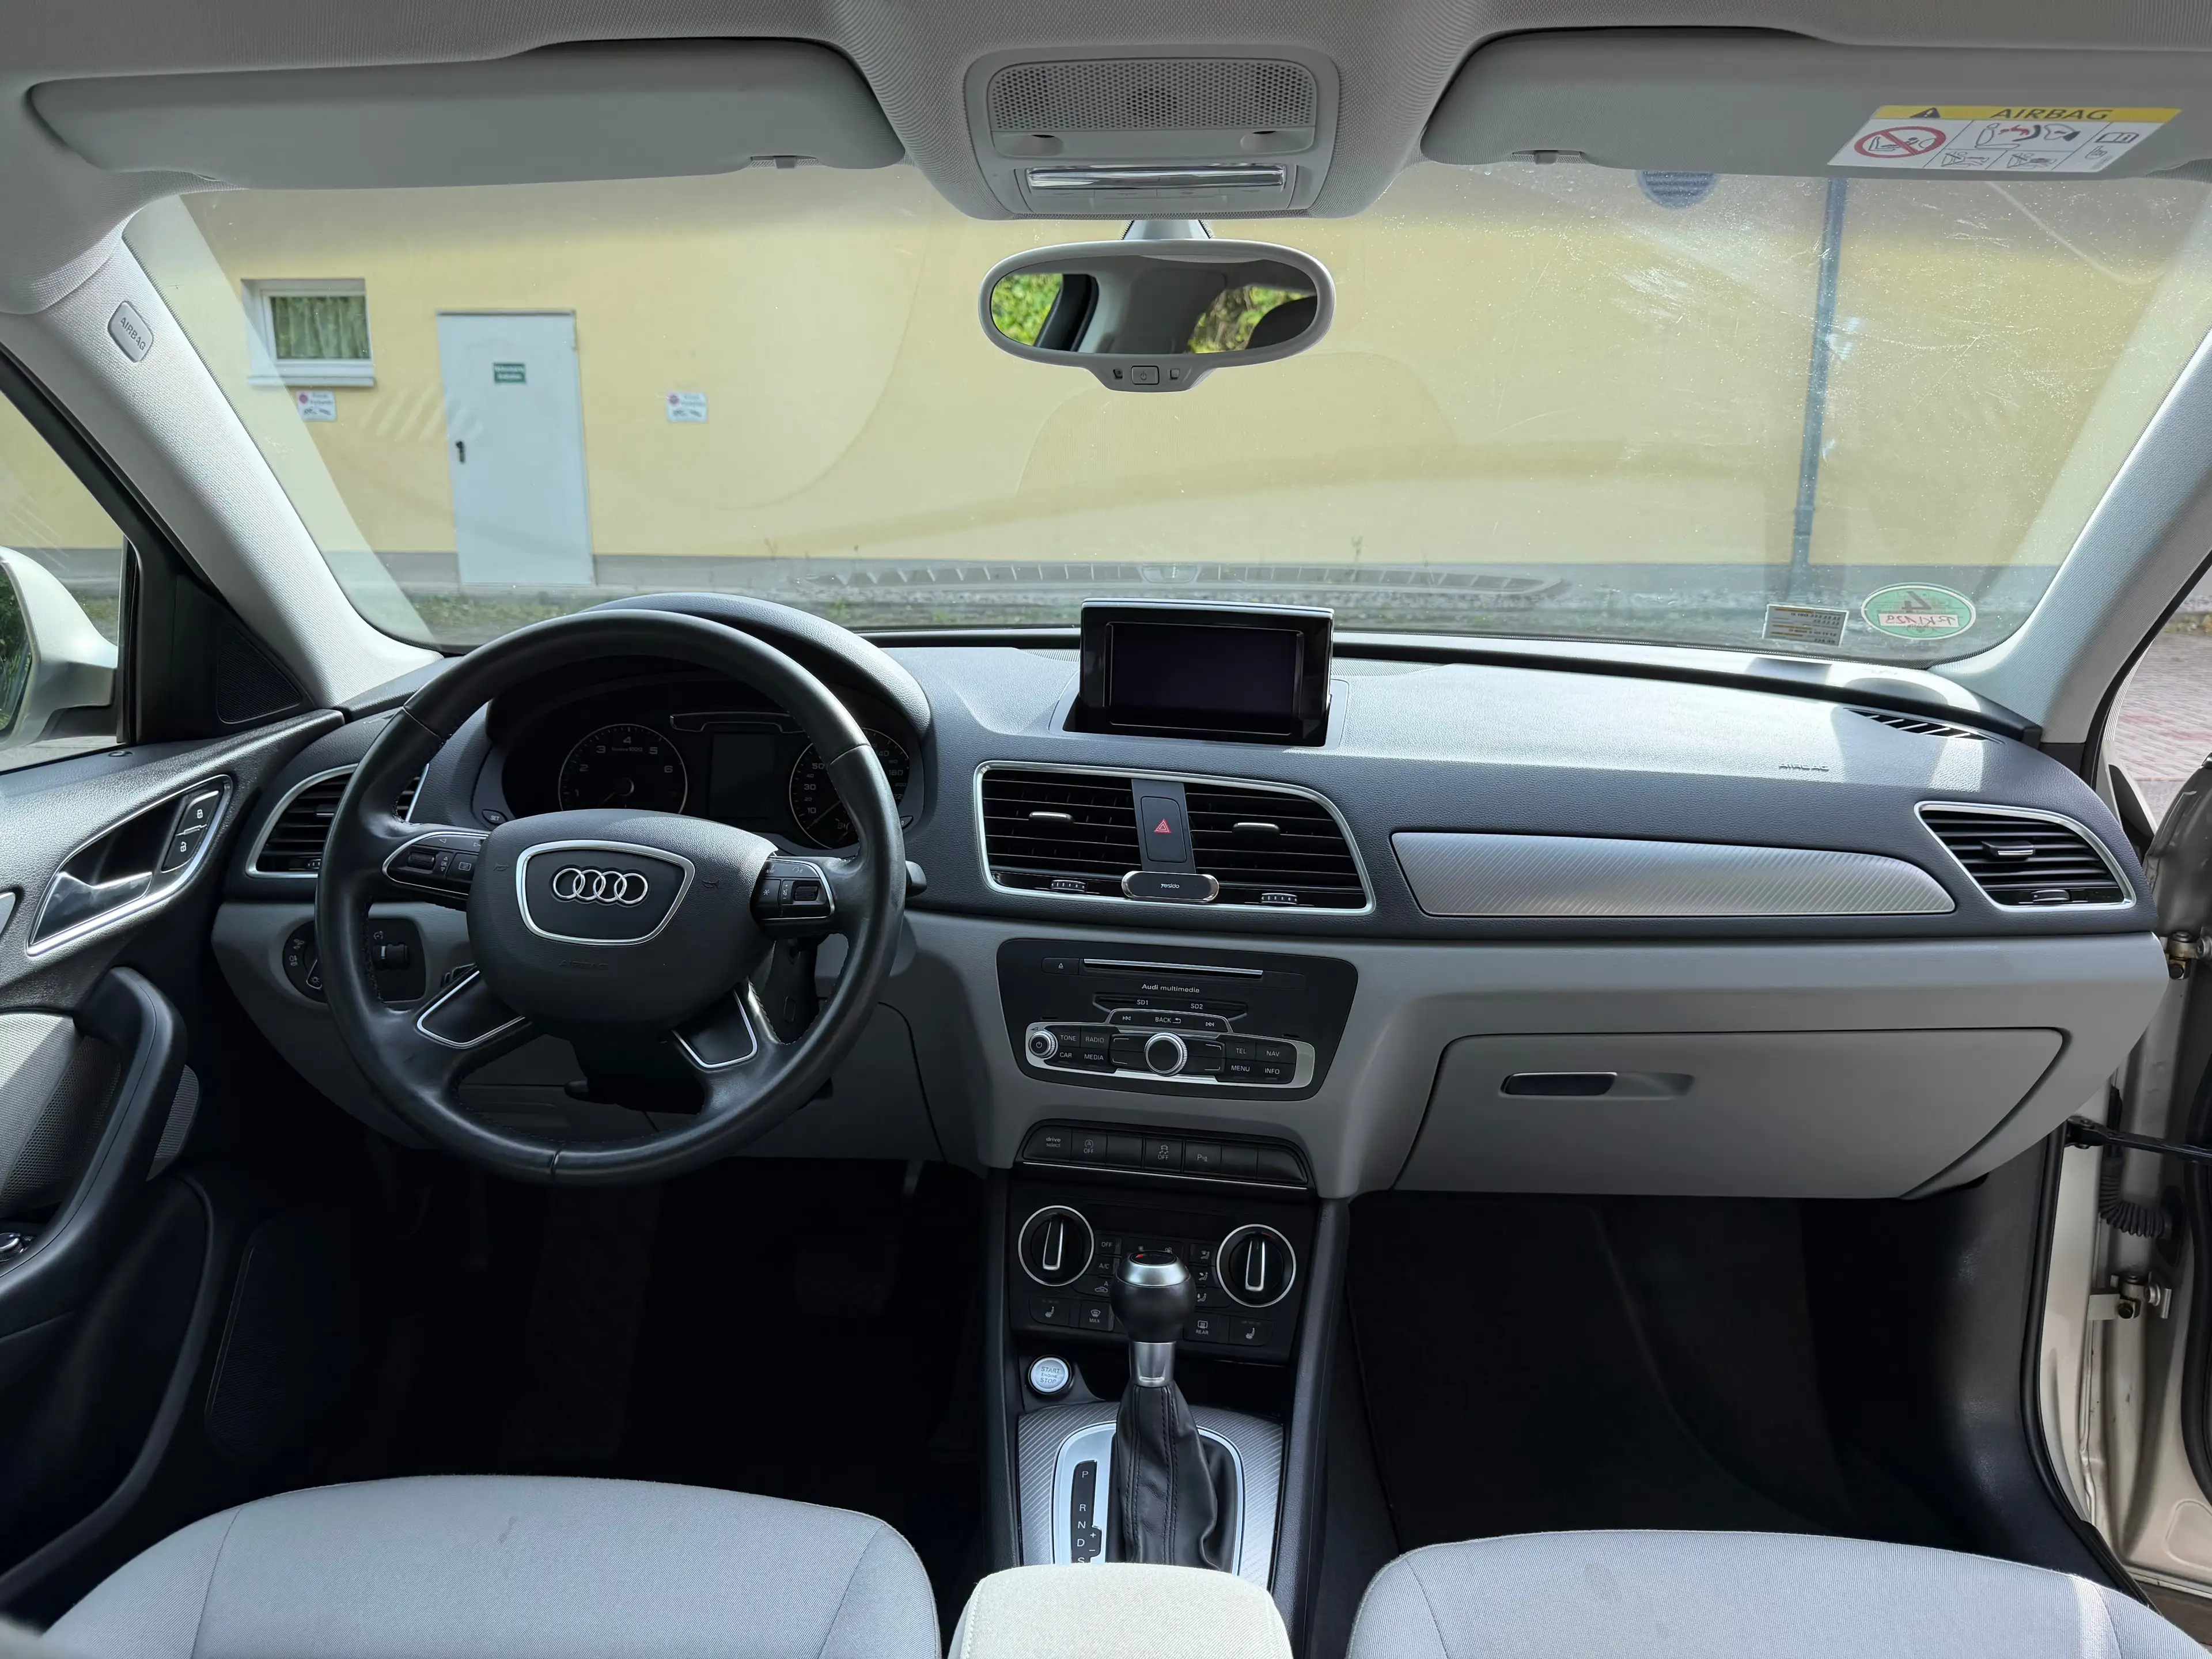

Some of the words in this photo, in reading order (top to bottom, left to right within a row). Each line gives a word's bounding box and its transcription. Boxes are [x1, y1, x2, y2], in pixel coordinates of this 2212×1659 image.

[1990, 108, 2113, 120] AIRBAG
[120, 317, 146, 351] AIRBAG
[596, 745, 606, 753] 3
[649, 747, 658, 755] 5
[579, 764, 589, 772] 2
[574, 789, 579, 797] 1
[559, 959, 609, 971] AIRBAG
[1160, 984, 1200, 993] multimedia
[1060, 1034, 1077, 1042] TONE
[1085, 1036, 1104, 1044] RADIO
[1082, 1471, 1089, 1479] P
[1079, 1503, 1086, 1512] R
[1077, 1521, 1086, 1529] N
[1077, 1539, 1085, 1547] D
